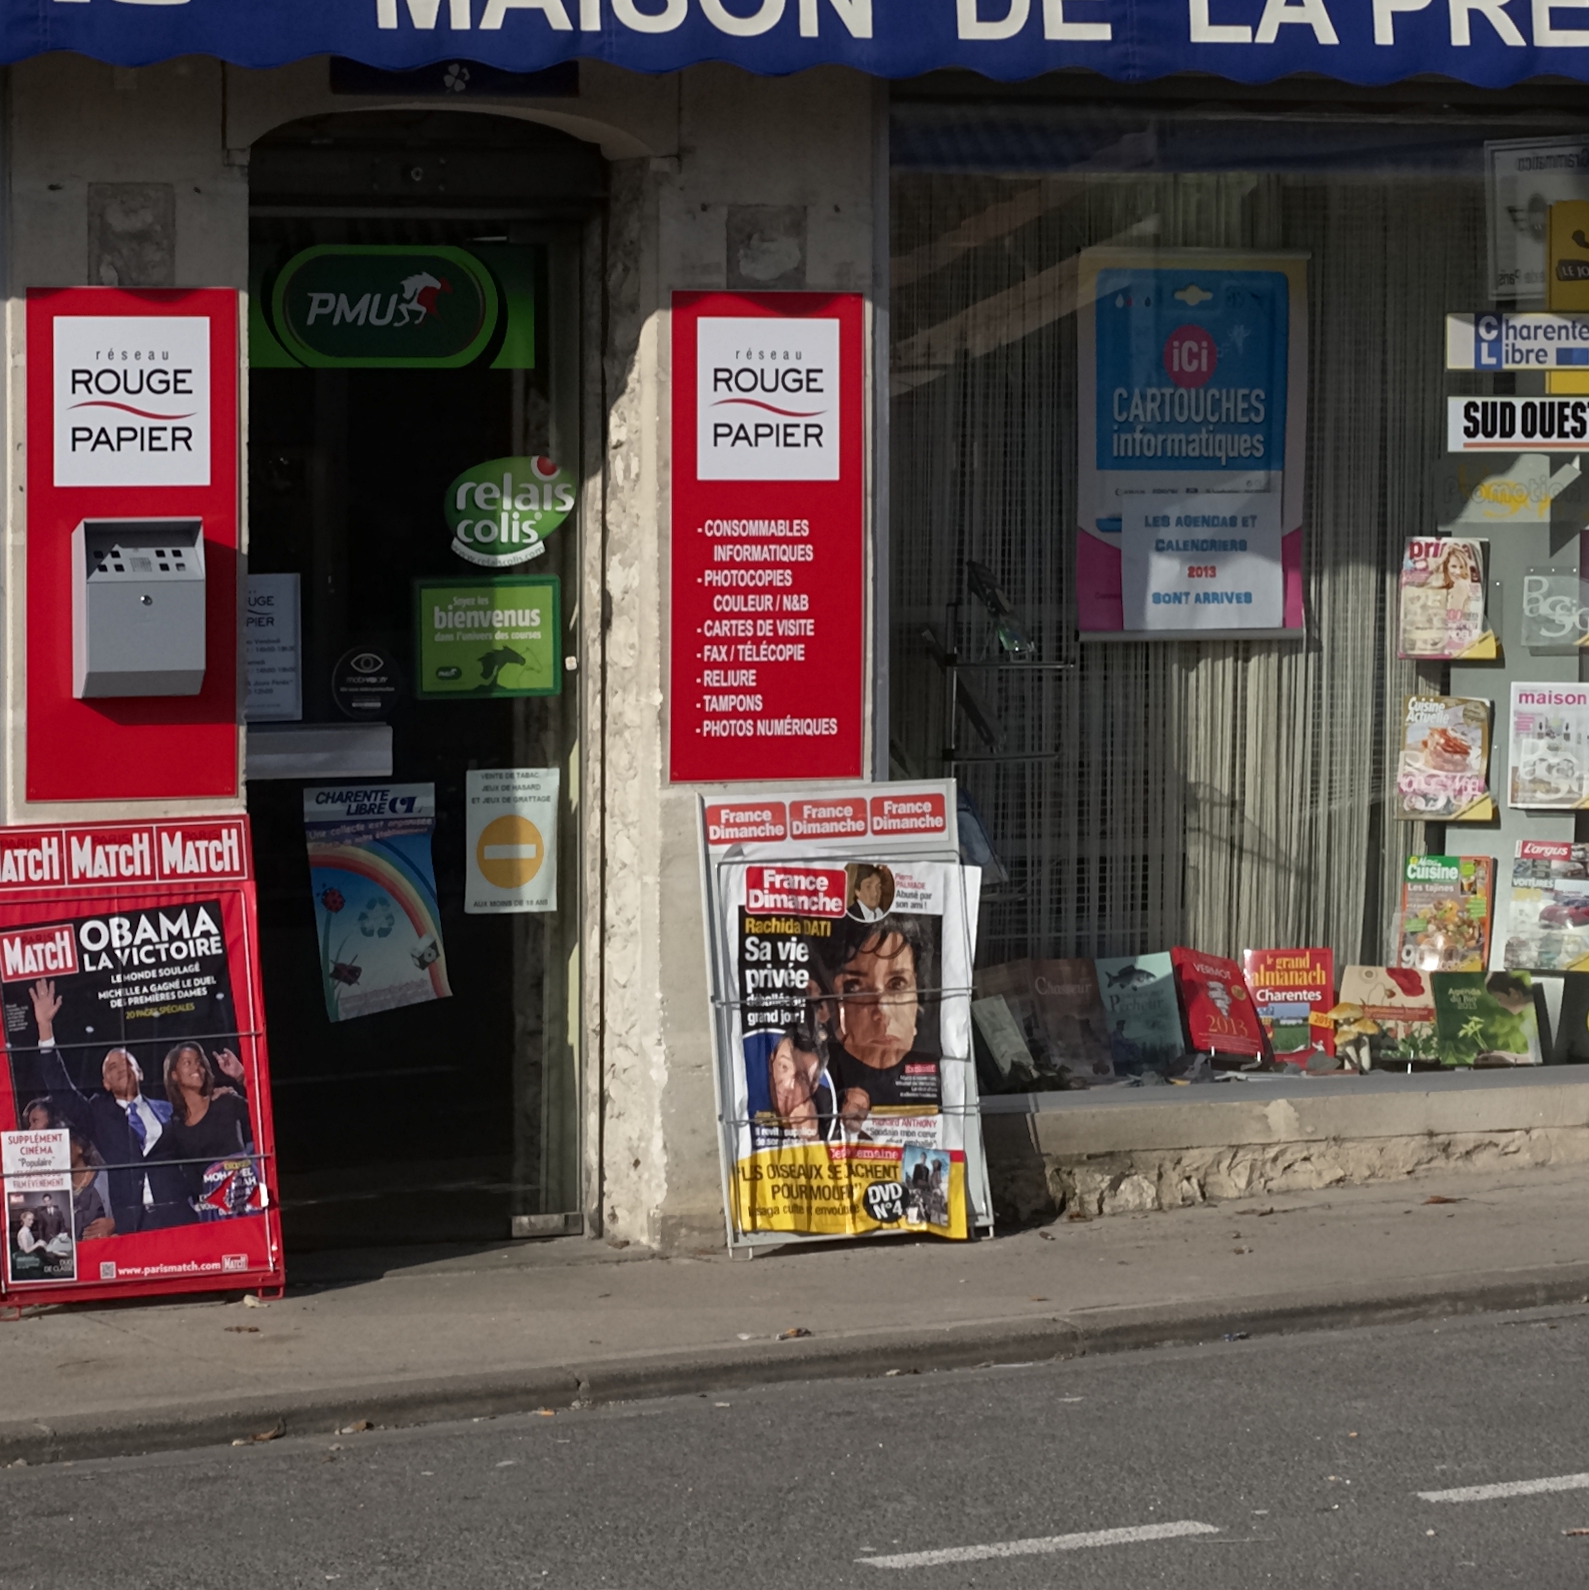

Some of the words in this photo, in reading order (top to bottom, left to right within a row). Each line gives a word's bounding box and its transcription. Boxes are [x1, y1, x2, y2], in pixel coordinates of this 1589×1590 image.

[1562, 265, 1576, 276] LE
[307, 292, 399, 326] PMU
[96, 349, 170, 362] réseau
[735, 348, 803, 361] réseau
[1480, 344, 1548, 365] Libre
[71, 369, 193, 395] ROUGE
[713, 368, 824, 393] ROUGE
[1113, 387, 1266, 423] CARTOUCHES
[1463, 401, 1517, 439] SUD
[72, 427, 193, 452] PAPIER
[713, 423, 824, 448] PAPIER
[1112, 424, 1264, 467] informatiques
[456, 472, 575, 512] relais
[1144, 515, 1171, 528] LES
[1174, 514, 1238, 528] AGENDAS
[1241, 514, 1257, 528] ET
[714, 545, 813, 562] INFORMATIQUES
[1155, 538, 1247, 553] CALENDRIERS
[714, 595, 771, 612] COULEUR
[783, 594, 809, 611] N&B
[1152, 591, 1190, 605] SONT
[1194, 590, 1253, 604] ARRIVES
[434, 604, 541, 629] bienvenus
[704, 620, 750, 637] CARTES
[754, 620, 773, 636] DE
[777, 619, 815, 636] VISITE
[704, 645, 727, 662] FAX
[737, 641, 805, 661] TÉLÉCOPIE
[1519, 691, 1587, 705] maison
[703, 720, 754, 737] PHOTOS
[756, 715, 838, 736] NUMÉRIQUES
[315, 790, 390, 804] CHARENTE
[346, 803, 386, 816] LIBRE
[720, 809, 772, 823] France
[803, 805, 853, 818] France
[883, 800, 932, 814] France
[709, 823, 785, 840] Dimanche
[792, 819, 865, 836] Dimanche
[873, 814, 943, 831] Dimanche
[762, 869, 829, 891] France
[1407, 863, 1458, 880] Cuisine
[1408, 883, 1423, 891] Les
[1425, 884, 1454, 893] tajines
[1513, 878, 1554, 888] VOITURES
[749, 889, 843, 912] Dimanche
[896, 890, 918, 899] Abusé
[920, 892, 932, 900] par
[79, 906, 219, 951] OBAMA
[745, 918, 801, 934] Rachida
[803, 920, 831, 937] DATI
[83, 952, 113, 972] LA
[114, 936, 223, 967] VICTOIRE
[745, 936, 772, 961] Sa
[777, 936, 809, 962] vie
[1193, 963, 1232, 980] VERMOT
[1266, 955, 1273, 965] le
[1276, 952, 1310, 970] grand
[111, 974, 122, 984] LE
[123, 970, 157, 983] MONDE
[158, 962, 200, 978] SOULAGÉ
[745, 962, 809, 994] privée
[1252, 963, 1326, 987] almanach
[98, 986, 141, 1000] MICHELLE
[142, 985, 149, 994] A
[150, 978, 180, 993] GAGNÉ
[182, 979, 192, 989] LE
[193, 975, 216, 987] DUEL
[110, 998, 126, 1009] DES
[128, 989, 176, 1006] PREMIÈRES
[177, 987, 208, 1000] DAMES
[1256, 990, 1322, 1002] Charentes
[1208, 1015, 1248, 1037] 2013
[8, 1132, 63, 1145] SUPPLÉMENT
[20, 1145, 53, 1155] CINÉMA
[867, 1183, 903, 1205] DVD
